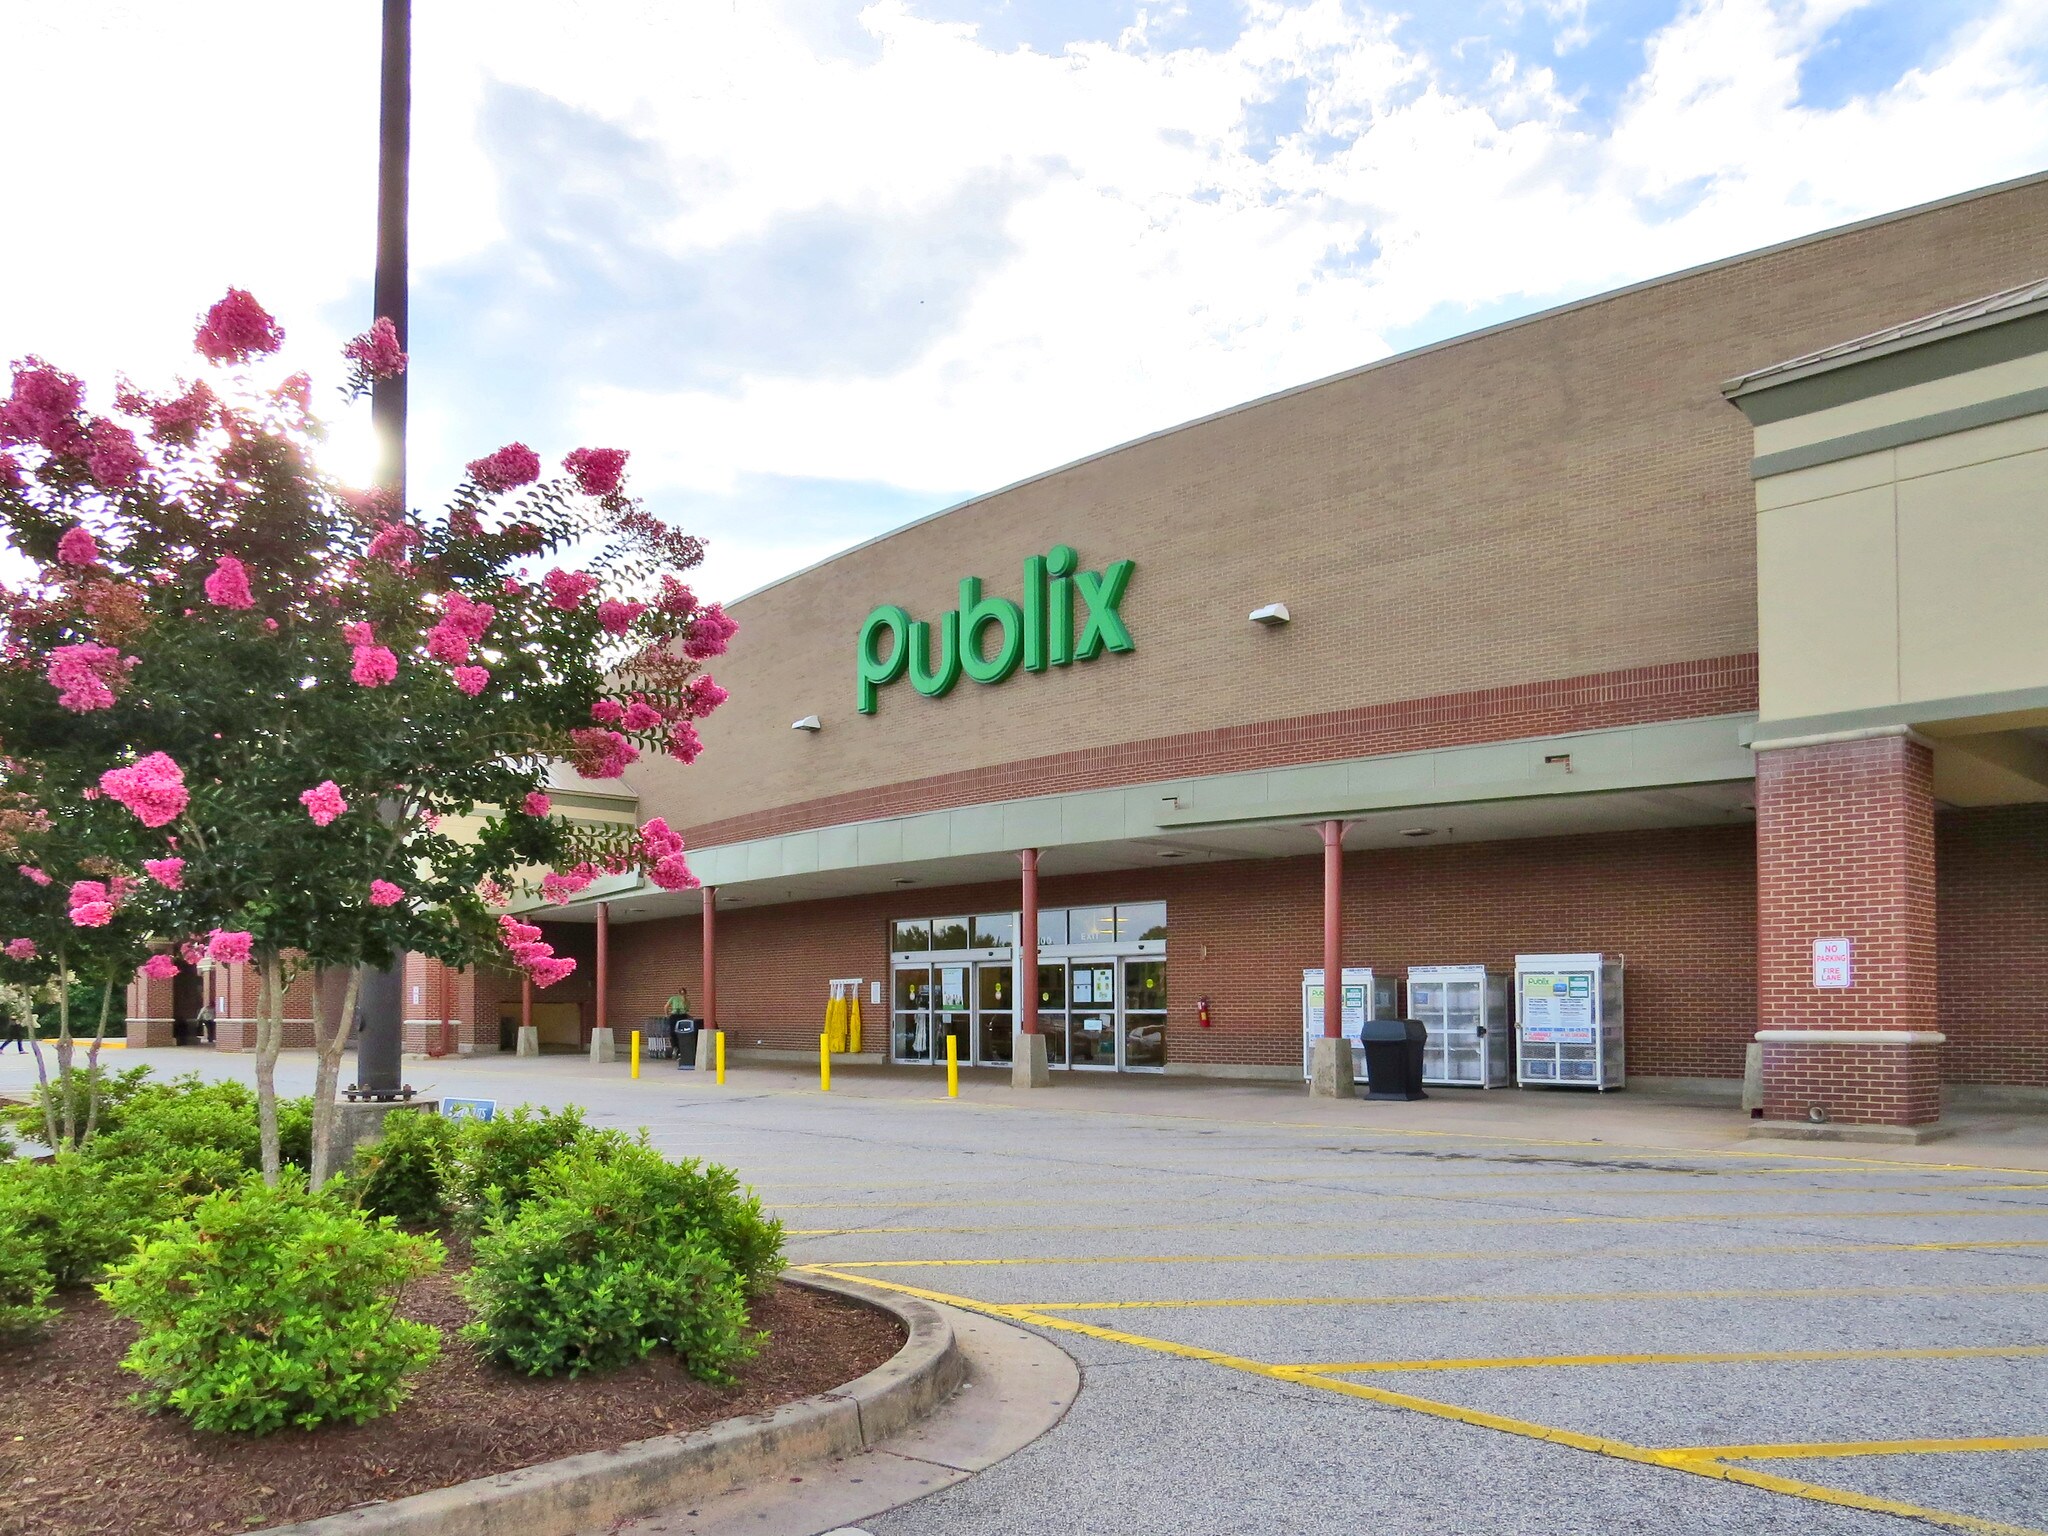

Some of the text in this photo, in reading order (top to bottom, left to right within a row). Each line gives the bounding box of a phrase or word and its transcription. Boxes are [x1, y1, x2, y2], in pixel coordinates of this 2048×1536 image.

[857, 544, 1136, 714] Publix
[1081, 933, 1099, 941] EXIT
[1825, 945, 1838, 953] NO
